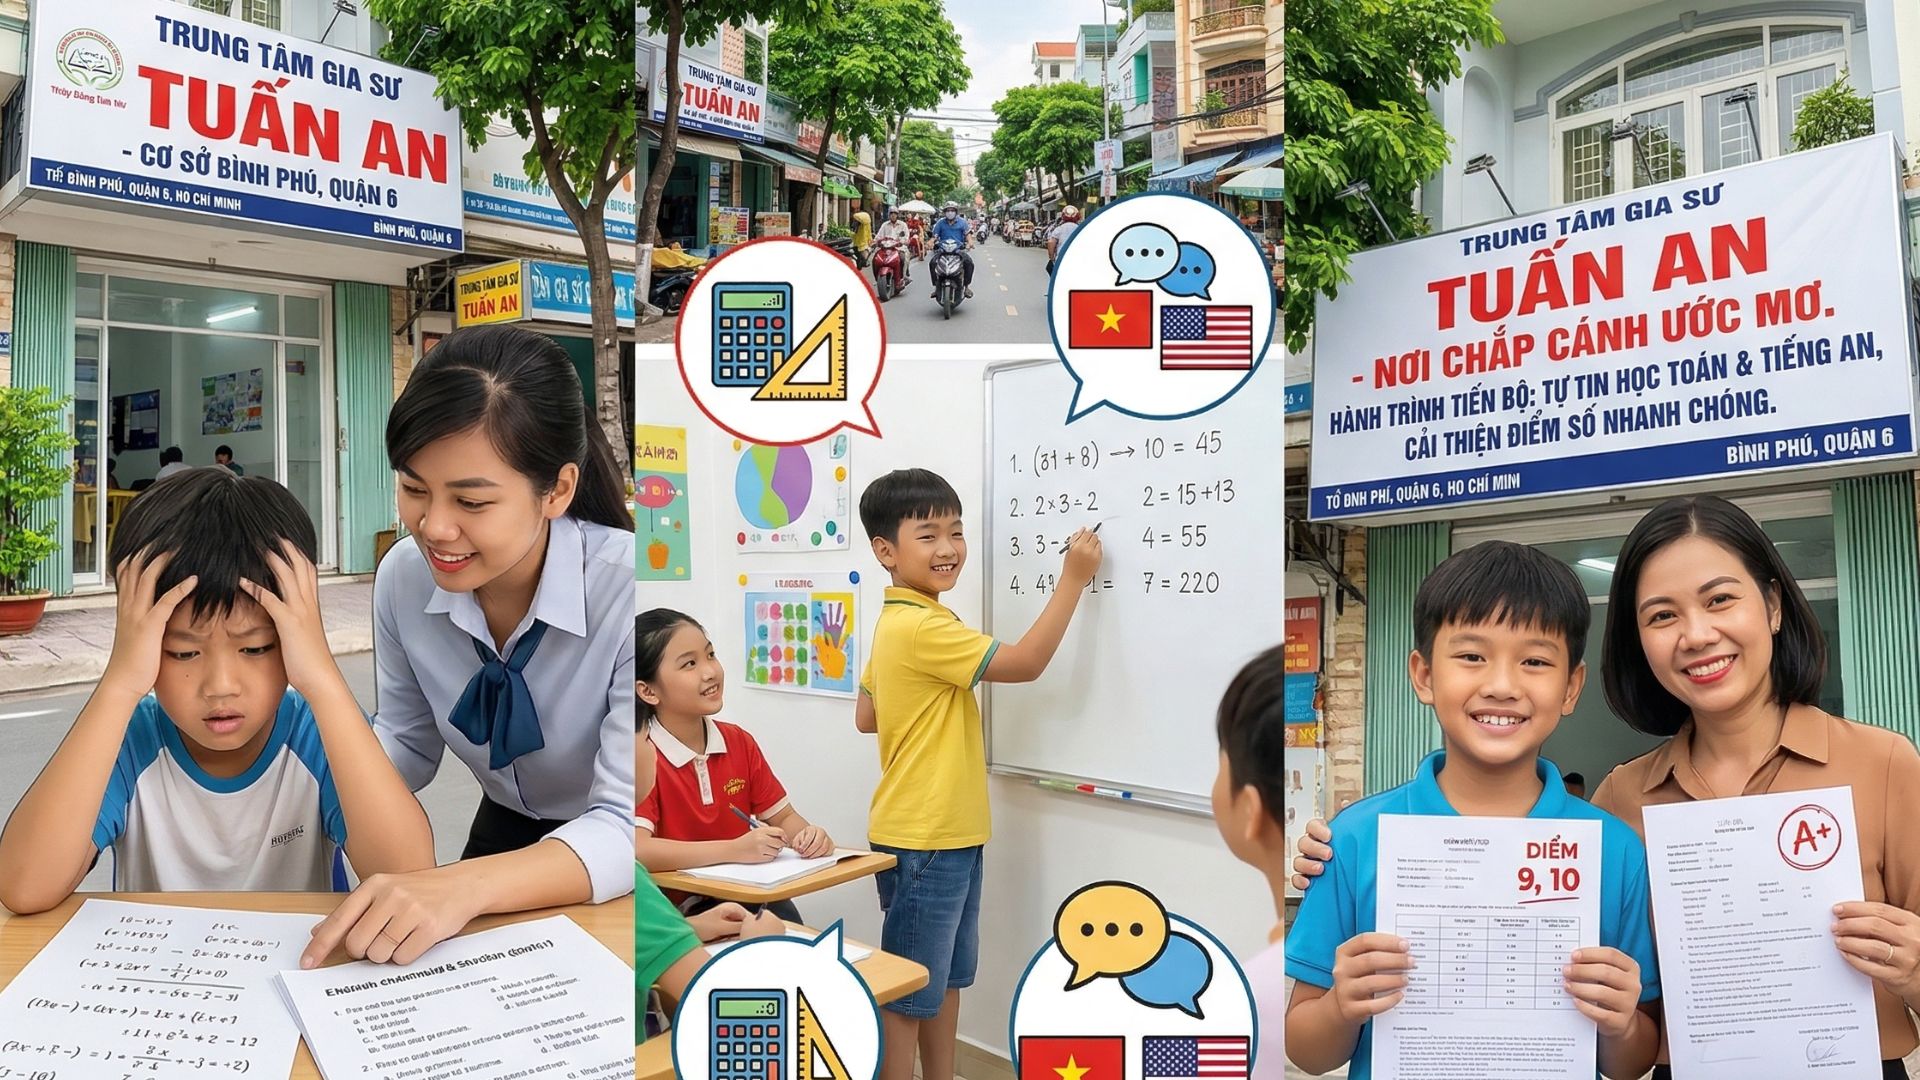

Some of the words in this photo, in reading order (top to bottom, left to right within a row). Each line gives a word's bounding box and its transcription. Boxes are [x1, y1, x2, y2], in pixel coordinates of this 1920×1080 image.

[155, 15, 249, 63] TRUNG
[258, 42, 314, 79] TÂM
[322, 60, 362, 92] GIA
[369, 71, 402, 101] SƯ
[688, 64, 714, 84] TRUNG
[733, 80, 746, 93] GIA
[683, 82, 733, 117] TUẤN
[736, 100, 760, 123] AN
[138, 64, 340, 163] TUẤN
[362, 119, 447, 184] AN
[99, 176, 126, 195] PHÚ,
[128, 182, 160, 200] QUẬN
[162, 188, 173, 202] 6,
[193, 192, 211, 207] CHÍ
[213, 195, 241, 211] MINH
[140, 142, 174, 168] CƠ
[180, 146, 211, 176] SỞ
[217, 153, 269, 186] BÌNH
[276, 168, 323, 198] PHÚ,
[329, 178, 380, 208] QUẬN
[386, 187, 398, 208] 6
[373, 218, 396, 236] BÌNH
[420, 228, 445, 245] QUẬN
[446, 233, 453, 244] 6
[1460, 221, 1547, 256] TRUNG
[1556, 206, 1615, 236] TÂM
[1625, 196, 1672, 222] GIA
[1683, 182, 1724, 210] SƯ
[1428, 237, 1624, 331] TUẤN
[1653, 217, 1767, 292] AN
[500, 294, 518, 313] AN
[1375, 349, 1430, 389] NƠI
[1442, 324, 1535, 378] CHẮP
[1548, 313, 1648, 361] CÁNH
[1662, 294, 1741, 343] ƯỚC
[1756, 280, 1835, 328] MƠ.
[1330, 405, 1382, 436] HÀNH
[1387, 395, 1445, 427] TRÌNH
[1451, 382, 1496, 418] TIẾN
[1502, 379, 1536, 415] BỘ:
[1542, 375, 1571, 409] TỰ
[1575, 370, 1609, 400] TIN
[1616, 363, 1661, 398] HỌC
[1668, 351, 1728, 386] TOÁN
[1736, 350, 1753, 376] &
[1760, 333, 1831, 374] TIẾNG
[1839, 331, 1883, 362] AN,
[1405, 427, 1437, 461] CẢI
[1443, 422, 1501, 458] THIỆN
[1507, 409, 1560, 448] ĐIỂM
[1567, 403, 1598, 440] SỐ
[1603, 401, 1680, 435] NHANH
[1689, 388, 1777, 424] CHÓNG.
[1010, 454, 1022, 473] 1.
[1145, 437, 1164, 459] 10
[1173, 442, 1184, 452] =
[1196, 430, 1222, 455] 45
[1726, 441, 1769, 465] BÌNH
[1775, 433, 1819, 459] PHÚ,
[1824, 427, 1876, 456] QUẬN
[1882, 427, 1894, 446] 6
[1010, 497, 1024, 518] 2.
[1142, 486, 1154, 507] 2
[1160, 492, 1170, 502] =
[1396, 481, 1429, 504] QUẬN
[1433, 482, 1444, 499] 6,
[1447, 479, 1465, 496] HO
[1468, 473, 1489, 493] CHÍ
[1010, 536, 1024, 557] 3.
[1035, 534, 1046, 554] 3
[1142, 526, 1155, 549] 4
[1161, 533, 1172, 543] =
[1181, 525, 1208, 548] 55
[1010, 574, 1025, 595] 4.
[1144, 571, 1154, 594] 7
[1161, 579, 1170, 588] =
[1179, 571, 1220, 594] 220
[1794, 819, 1832, 856] A+
[1518, 867, 1542, 896] 9,
[1550, 867, 1580, 892] 10
